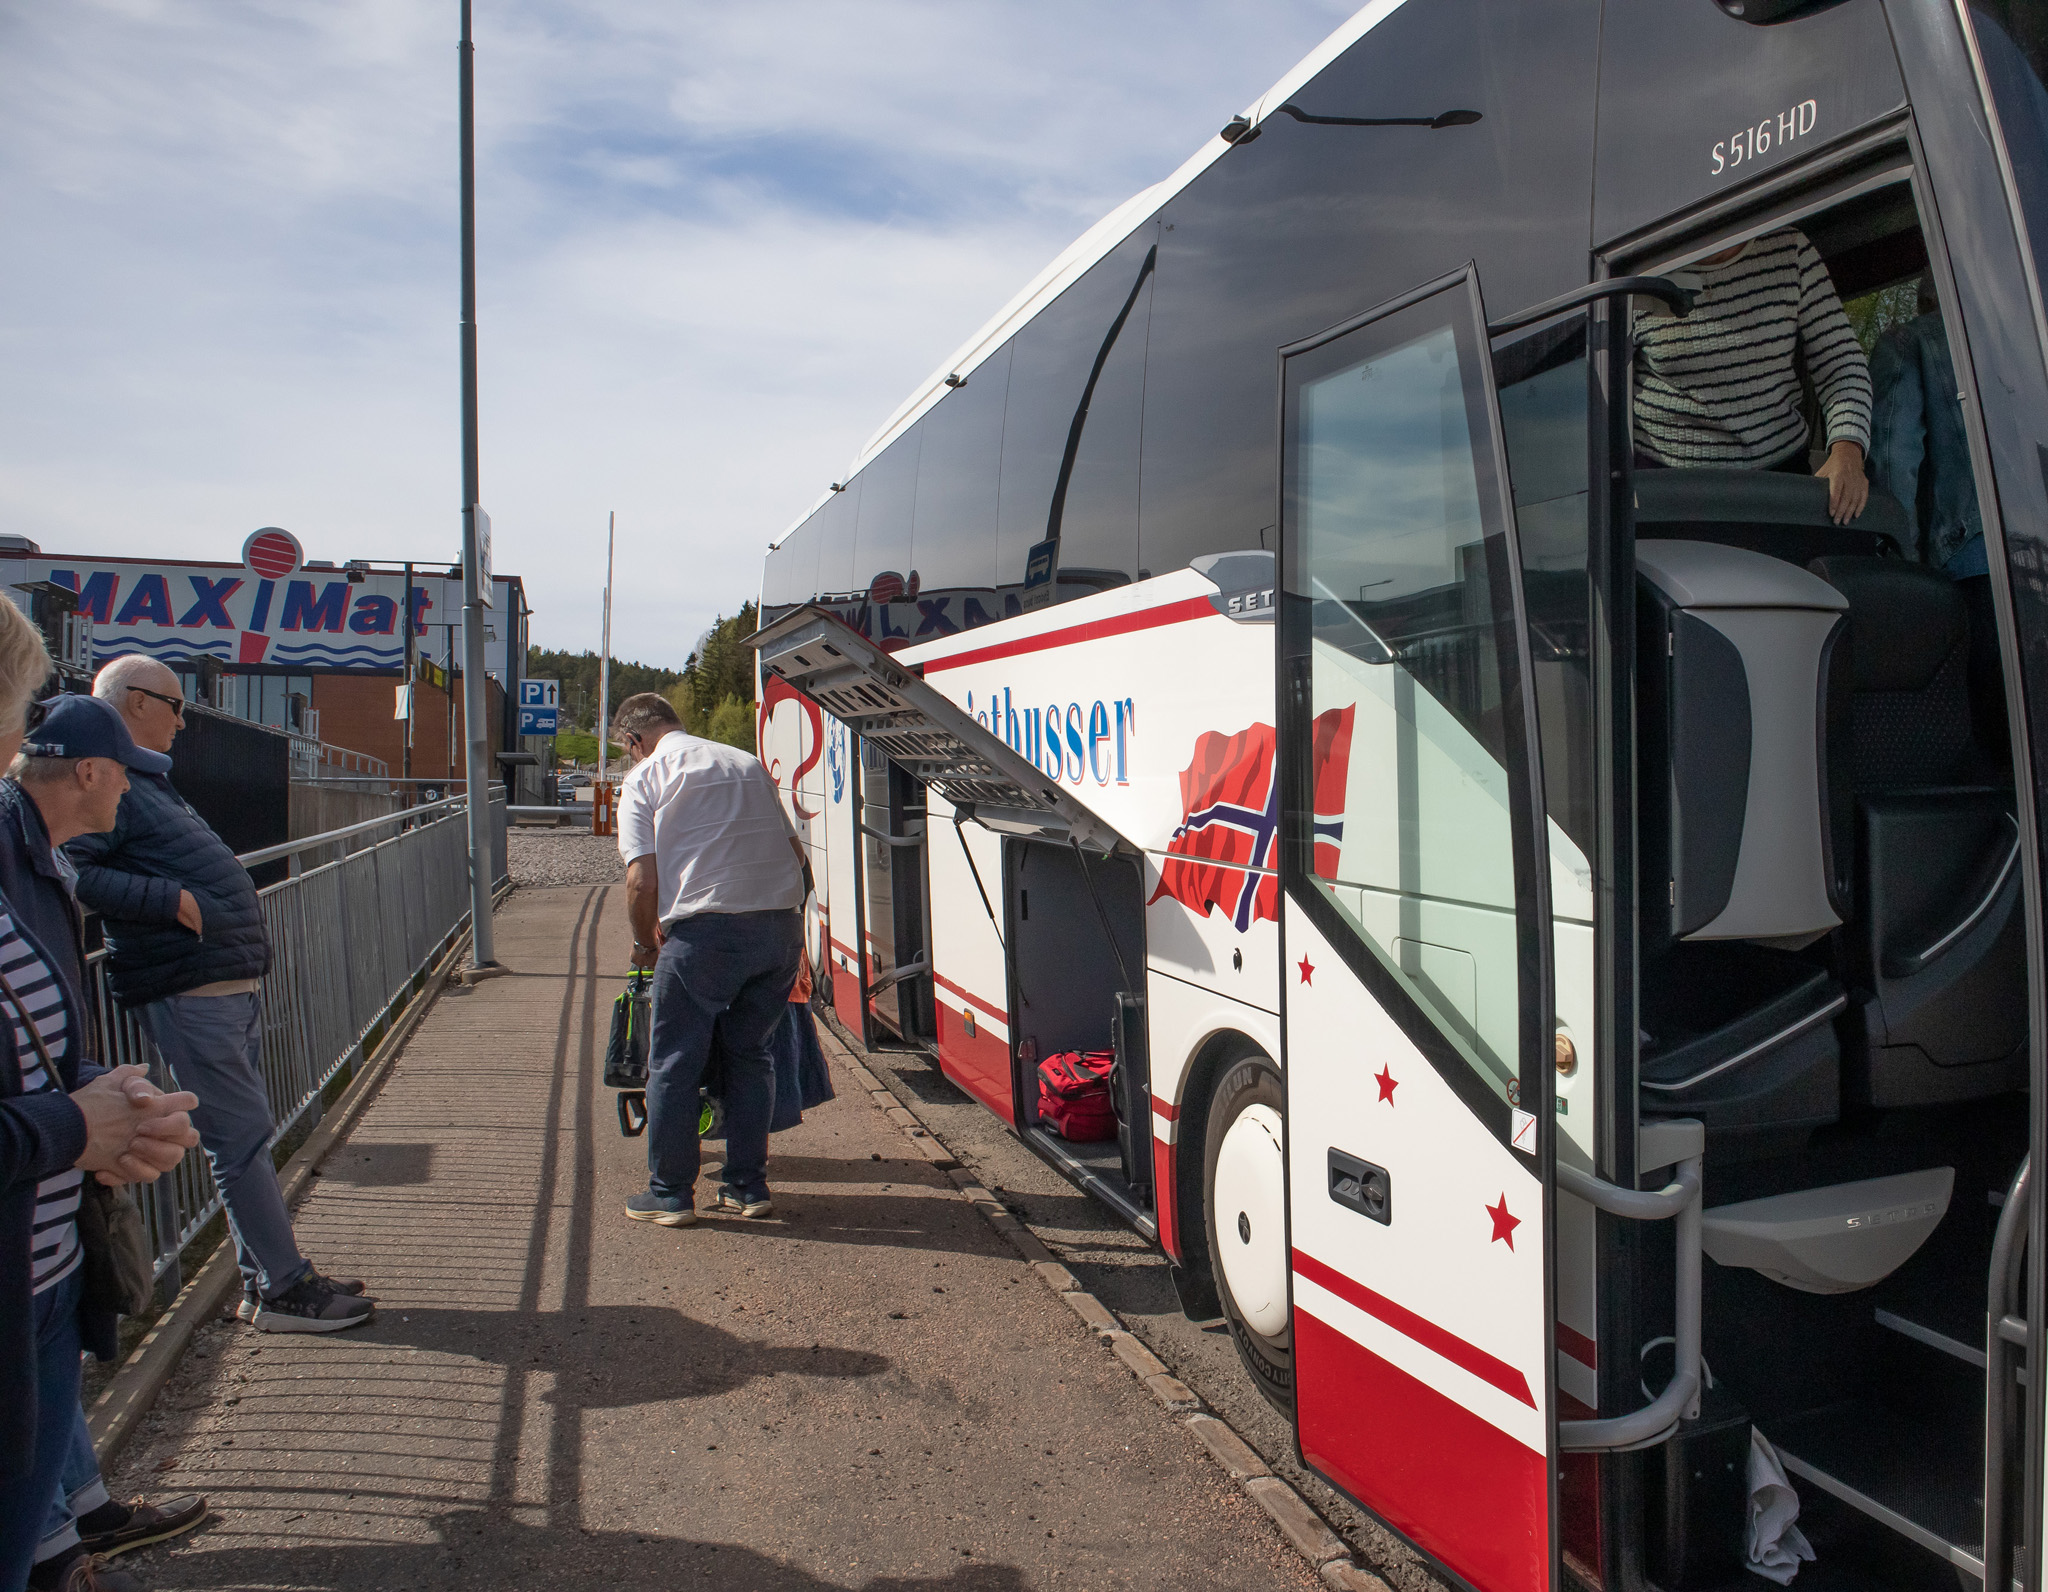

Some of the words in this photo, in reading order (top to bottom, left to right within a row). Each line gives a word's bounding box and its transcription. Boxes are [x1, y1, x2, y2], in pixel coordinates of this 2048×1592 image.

[1711, 141, 1725, 175] S
[1730, 119, 1771, 167] 516
[1777, 99, 1816, 145] HD
[526, 683, 541, 704] P
[521, 712, 534, 728] P
